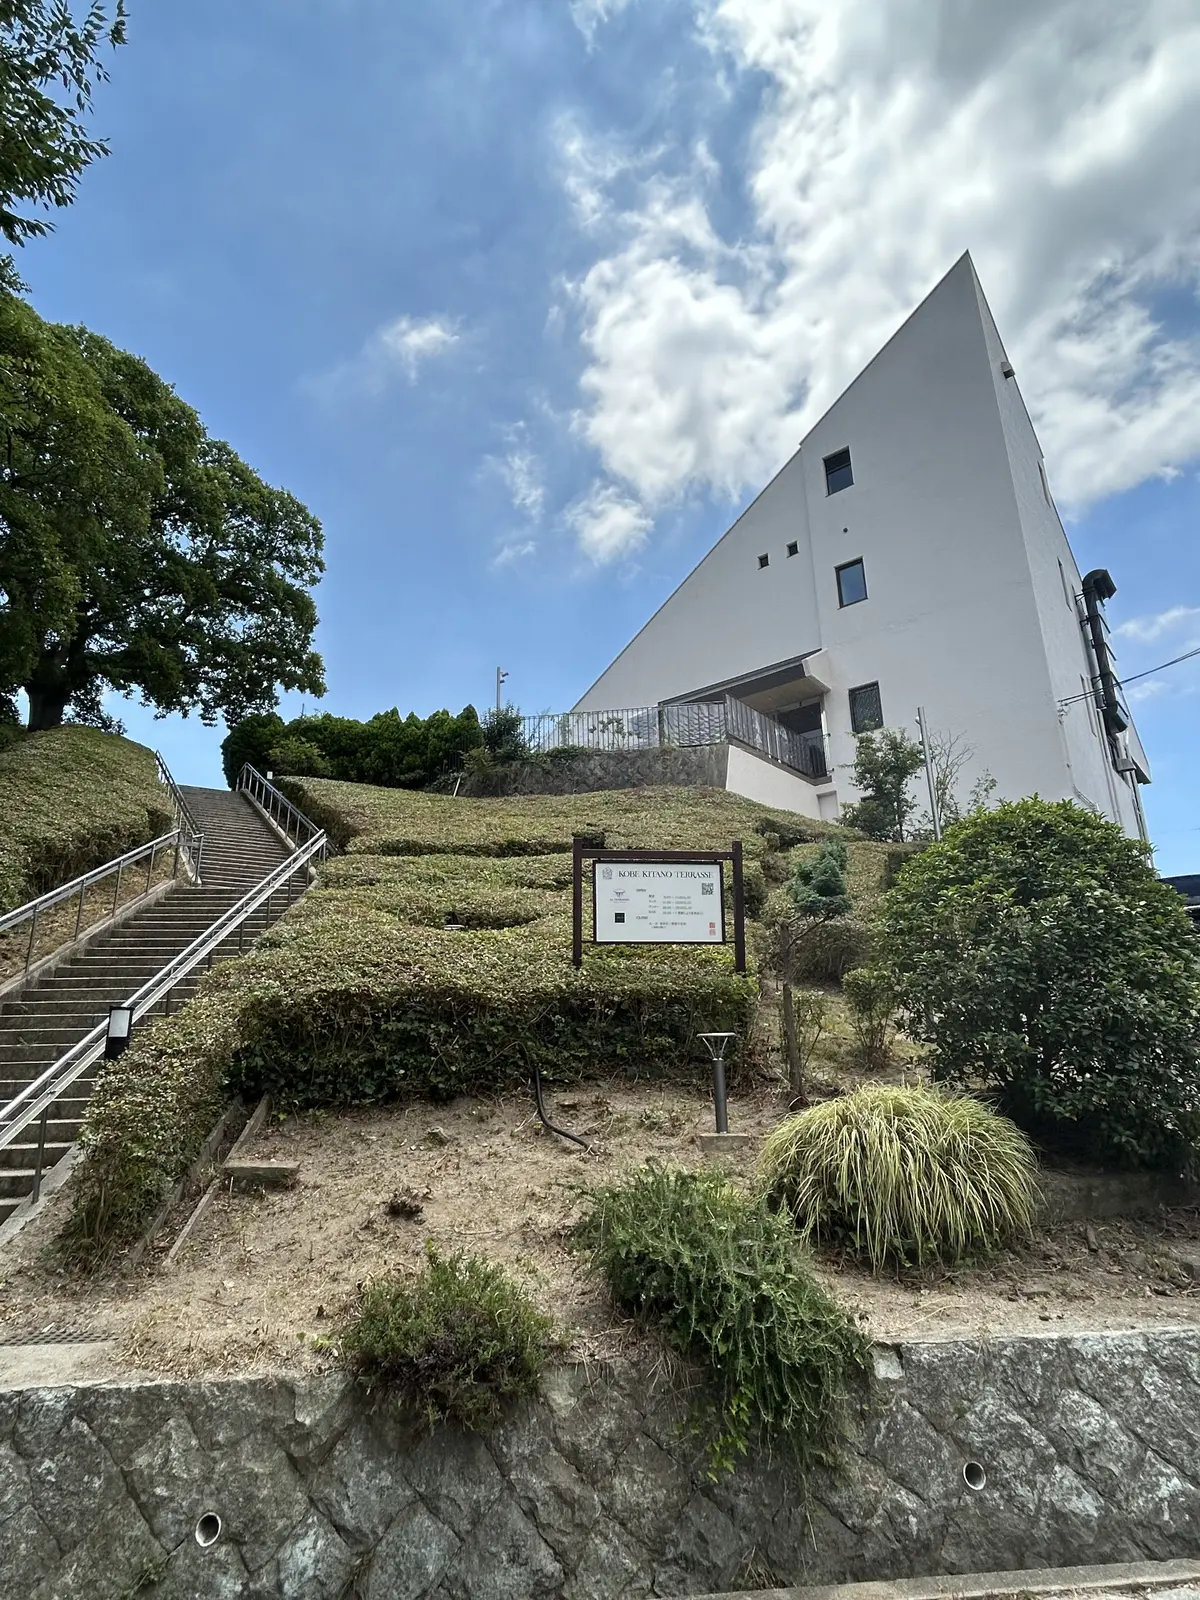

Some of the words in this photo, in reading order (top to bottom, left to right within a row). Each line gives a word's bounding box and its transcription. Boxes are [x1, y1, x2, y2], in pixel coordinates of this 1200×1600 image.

[618, 870, 640, 878] KOBE
[642, 870, 673, 878] KITANO
[675, 871, 713, 879] TERRASSE
